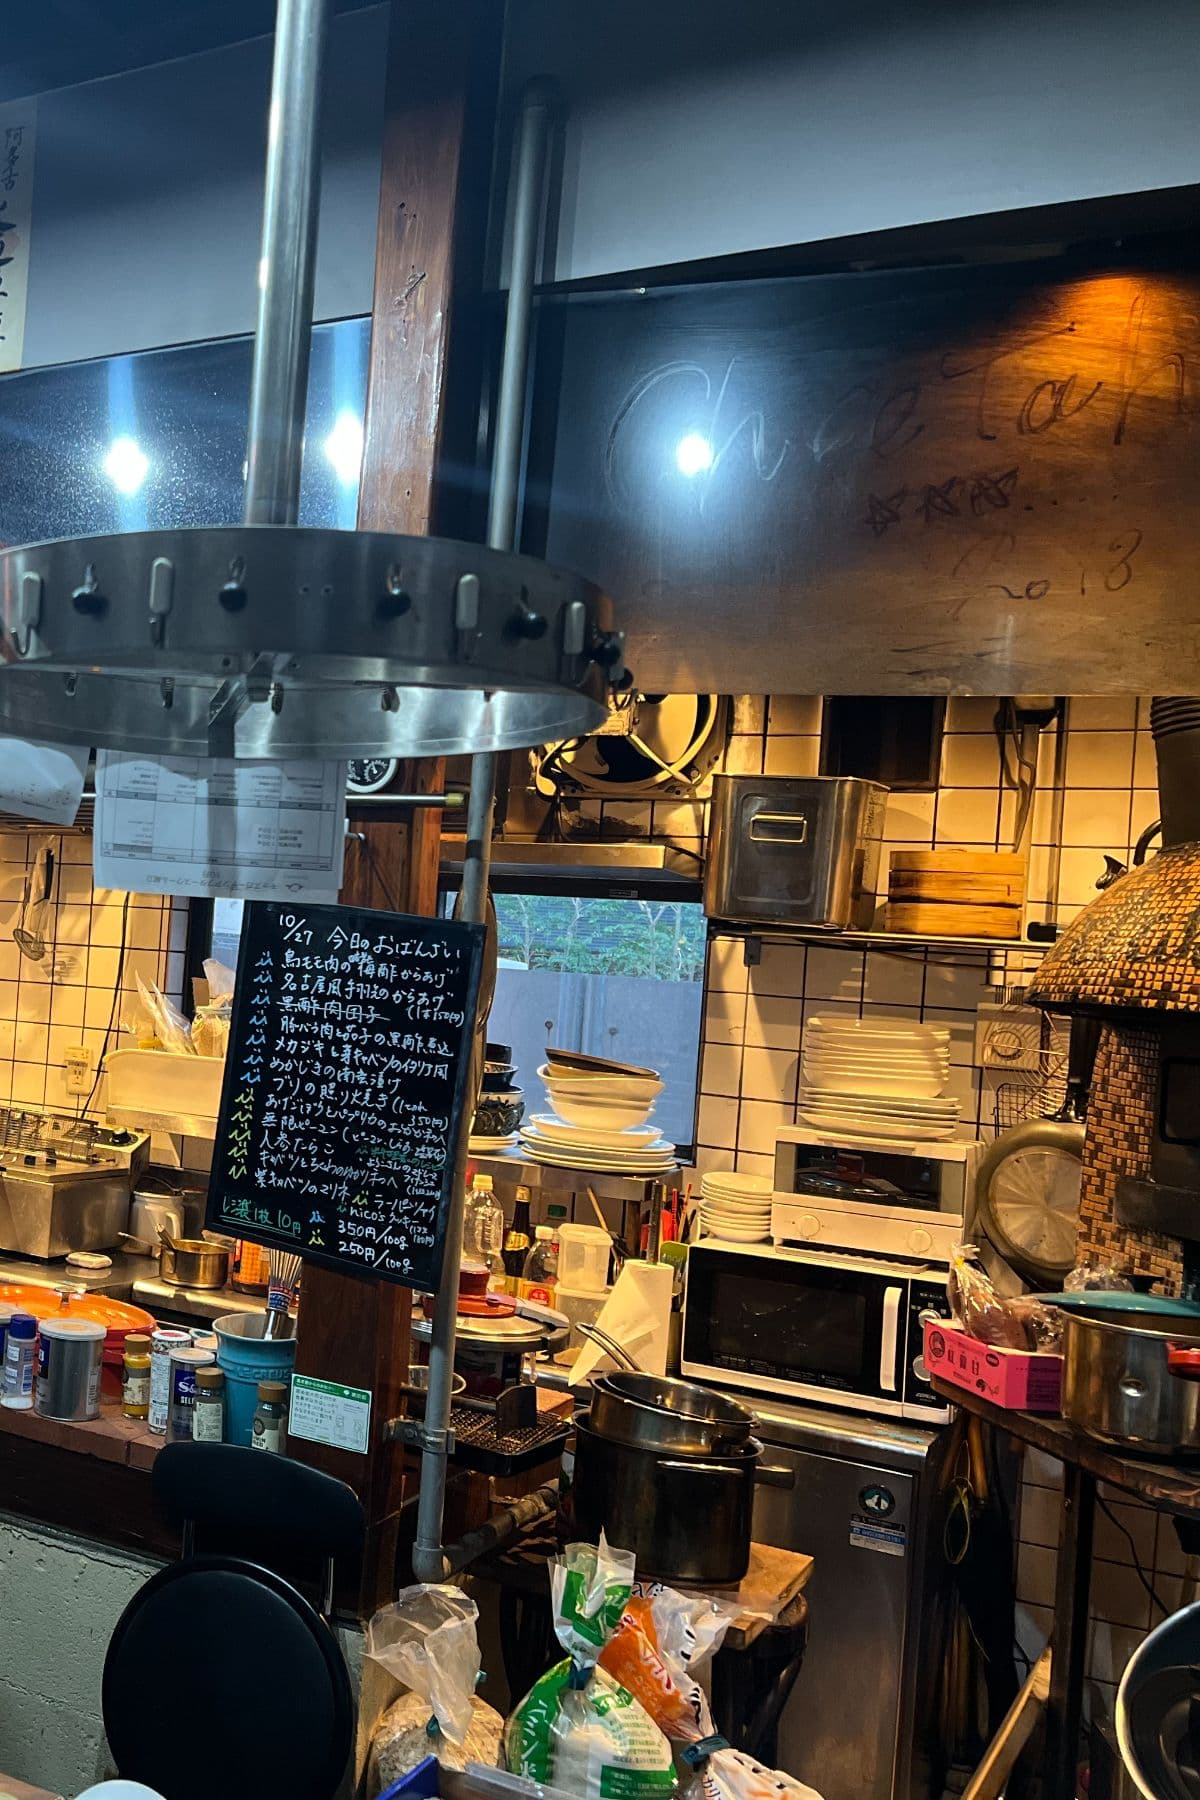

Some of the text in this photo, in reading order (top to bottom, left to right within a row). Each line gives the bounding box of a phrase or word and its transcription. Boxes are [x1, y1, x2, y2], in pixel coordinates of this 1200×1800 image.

[279, 914, 461, 959] 10/27 今日のおばんざい
